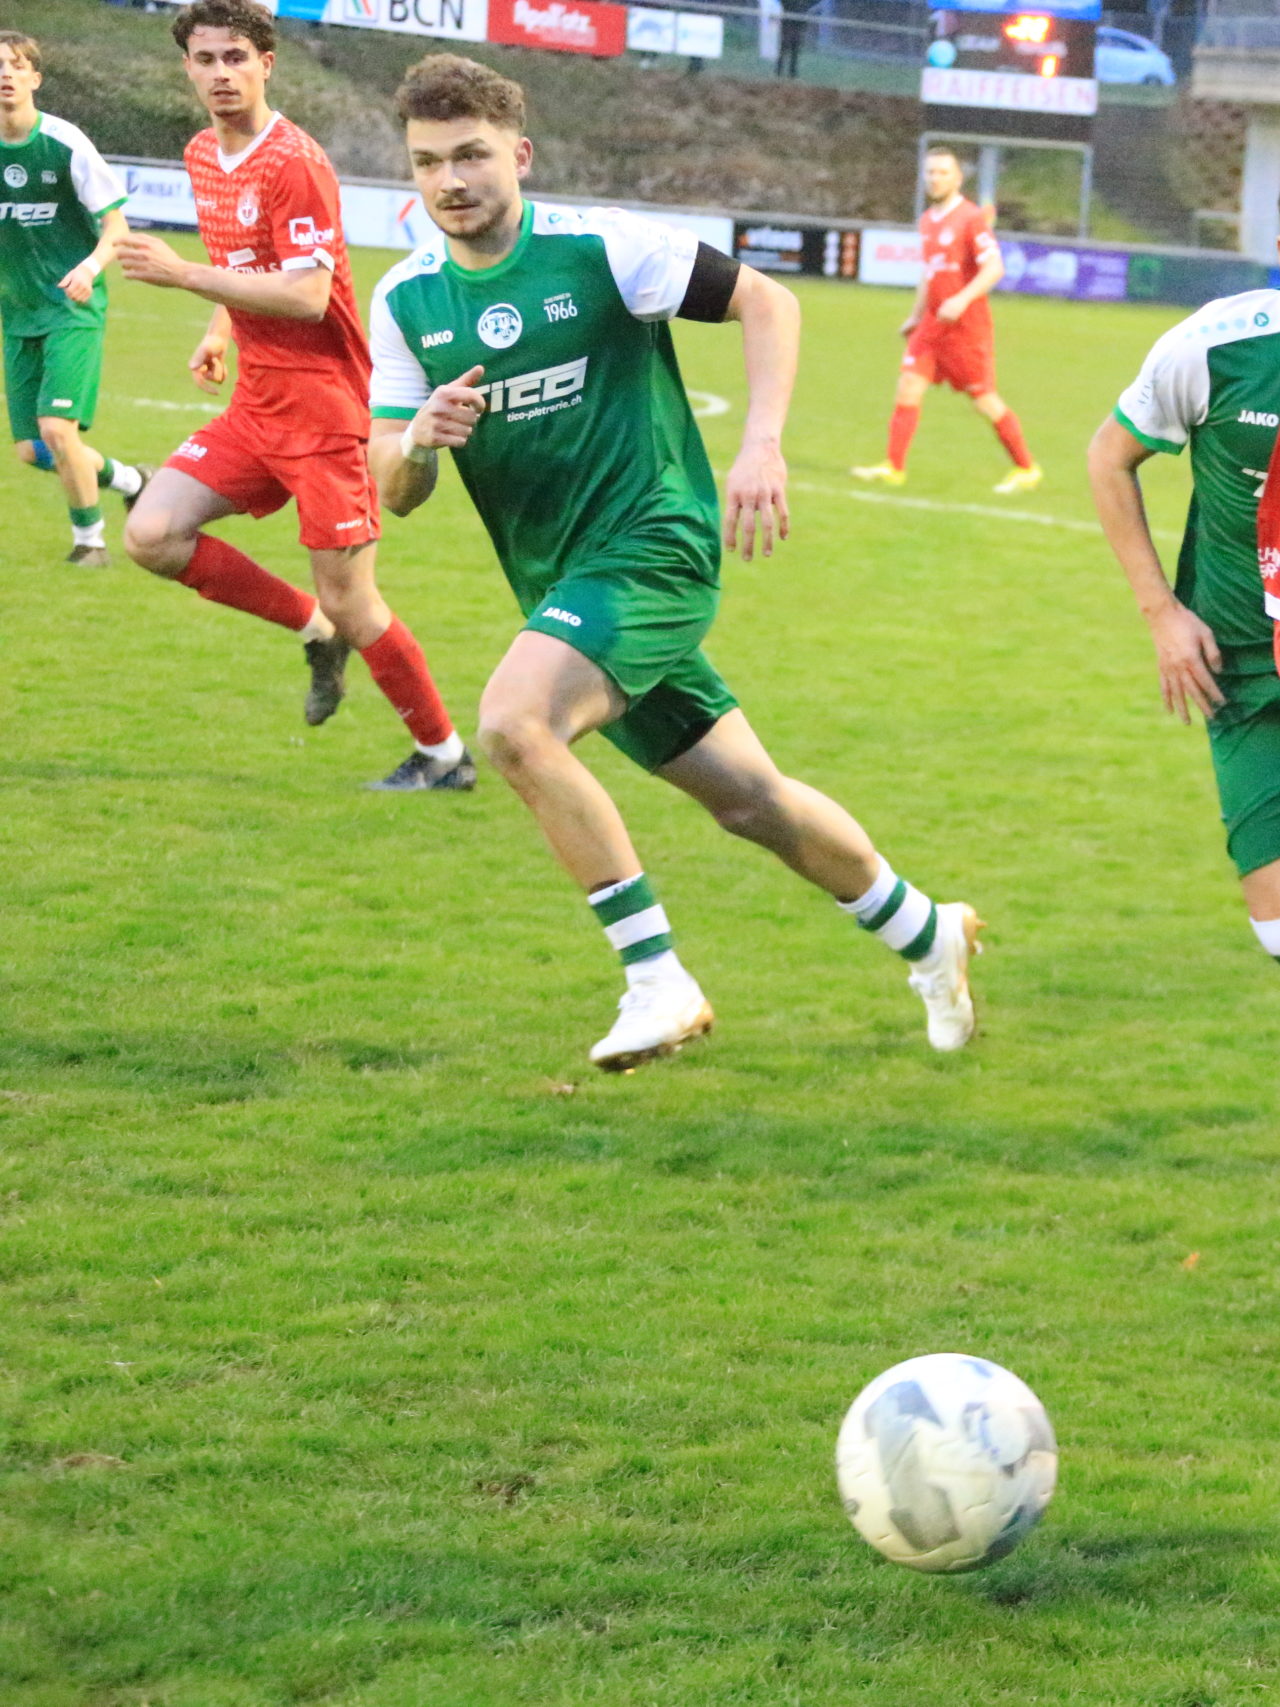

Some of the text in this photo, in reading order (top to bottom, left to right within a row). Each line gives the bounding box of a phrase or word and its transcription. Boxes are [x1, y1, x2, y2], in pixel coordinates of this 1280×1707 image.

[389, 0, 464, 29] BCN
[924, 74, 1093, 109] RAIFFEISEN
[543, 299, 578, 322] 1966
[1238, 409, 1279, 428] JAKO
[542, 606, 582, 627] JAKO
